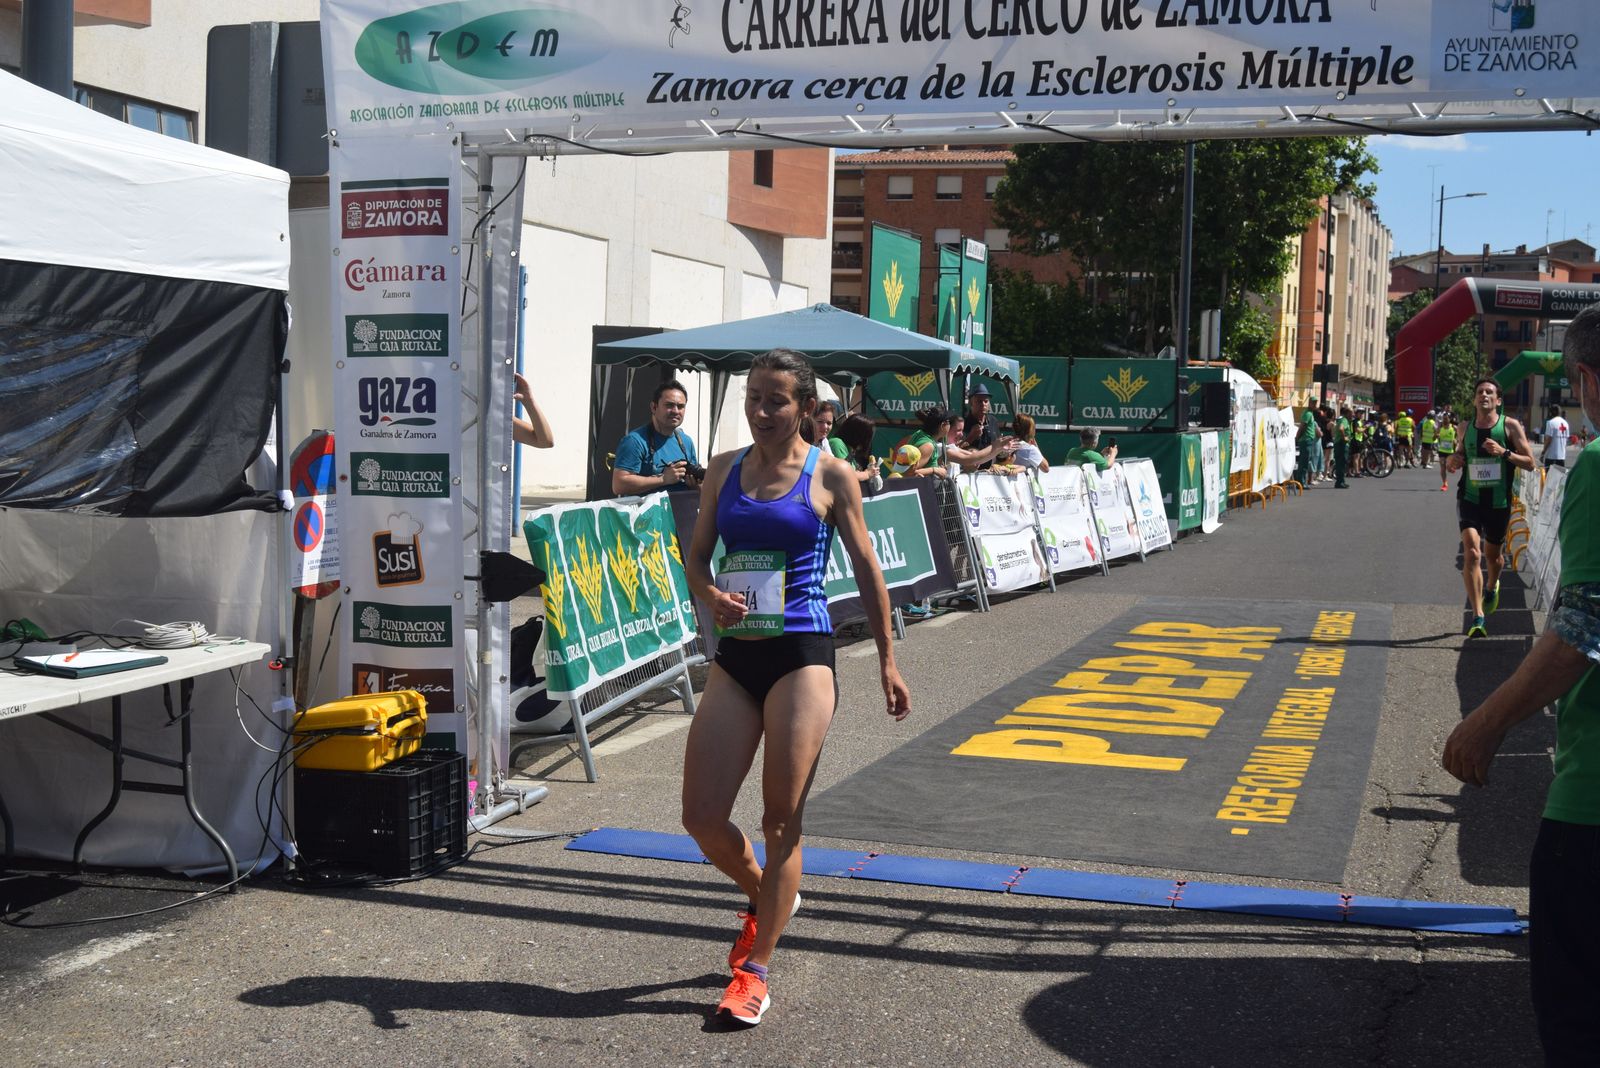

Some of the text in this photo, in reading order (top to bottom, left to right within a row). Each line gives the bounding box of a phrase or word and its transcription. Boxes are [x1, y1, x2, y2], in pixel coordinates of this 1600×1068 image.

[721, 0, 889, 53] CARRERA
[900, 0, 951, 43] del
[964, 0, 1087, 40] CERCO
[1445, 33, 1579, 53] AYUNTAMIENTO
[1444, 50, 1577, 72] DE ZAMORA
[647, 45, 1415, 104] Zamora cerca de la Esclerosis Múltiple
[350, 90, 625, 123] ASOCIACIÓN ZAMORANA DE ESCLEROSIS MÚLTIPLE
[365, 198, 443, 211] DIPUTACIÓN DE
[364, 210, 443, 228] ZAMORA
[382, 289, 411, 299] Zamora
[1551, 289, 1575, 298] CON
[1577, 290, 1591, 300] EL
[379, 329, 441, 341] FUNDACION
[379, 340, 441, 352] CAJA RURAL
[358, 376, 437, 427] gaza
[876, 399, 906, 412] CAJA
[987, 402, 1009, 415] AJA
[1082, 406, 1168, 420] CAJA RURAL
[360, 429, 437, 440] Ganaderos de Zamora
[381, 470, 443, 482] FUNDACION
[381, 480, 443, 493] CAJA RURAL
[378, 545, 416, 573] Susi
[745, 562, 774, 570] RURAL
[381, 619, 446, 632] FUNDACION
[748, 620, 778, 629] RURAL
[381, 630, 446, 643] CAJA RURAL
[949, 621, 1283, 771] PIDEPAR
[1261, 686, 1336, 741] INTEGRAL
[1216, 745, 1316, 824] REFORMA
